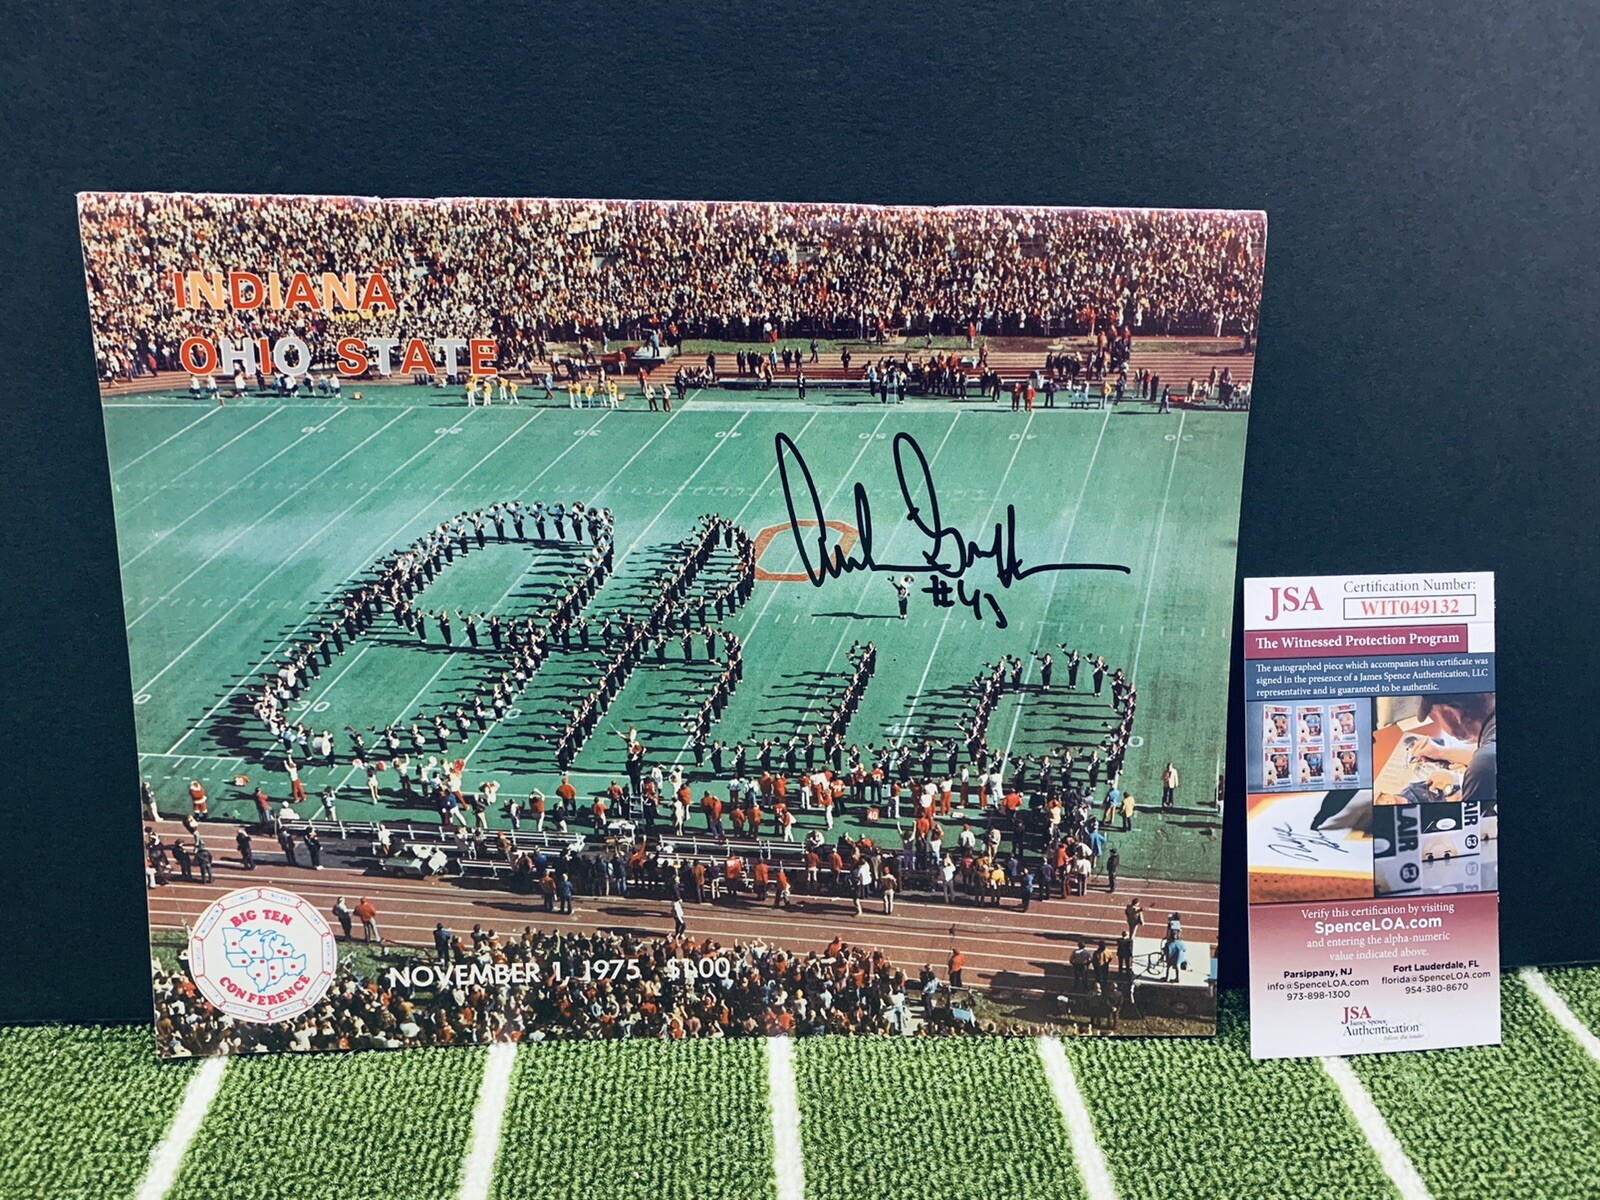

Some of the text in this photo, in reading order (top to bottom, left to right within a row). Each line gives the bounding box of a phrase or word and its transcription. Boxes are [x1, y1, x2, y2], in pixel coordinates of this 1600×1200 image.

[172, 271, 397, 310] INDIANA
[179, 336, 498, 375] OHIO STATE
[1343, 577, 1476, 593] Certification Number:
[1265, 586, 1324, 621] JSA
[1360, 599, 1459, 616] WIT049132
[1255, 631, 1460, 649] The Witnessed Protection Program
[1256, 656, 1489, 674] The autographed piece which accompanies this certificate was
[1256, 675, 1282, 687] signed
[1284, 675, 1292, 684] in
[1294, 674, 1307, 684] the
[1308, 674, 1342, 685] presence
[1343, 672, 1353, 681] of
[1360, 672, 1382, 682] James
[1383, 672, 1411, 682] Spence
[1412, 669, 1471, 680] Authentication,
[1472, 668, 1489, 677] LLC
[1256, 682, 1440, 699] representative and is guaranteed to be authentic.
[230, 910, 257, 928] BIG
[262, 909, 293, 926] TEN
[1301, 902, 1455, 921] Verify this certification by visiting
[1314, 917, 1442, 936] SpenceLOA.com
[1306, 931, 1451, 948] and entering the alpha-numeric
[1329, 947, 1430, 961] value indicated above.
[388, 962, 541, 989] NOVEMBER
[581, 957, 641, 984] 1975
[665, 956, 732, 981] $1.00
[1283, 967, 1353, 979] Parsippany, NJ
[1393, 960, 1480, 973] Fort Lauderdale, FL
[219, 975, 311, 1006] CONFERENCE
[1286, 990, 1351, 1001] 973-898-1300
[1405, 982, 1469, 994] 954-380-8670
[1341, 1006, 1372, 1025] JSA
